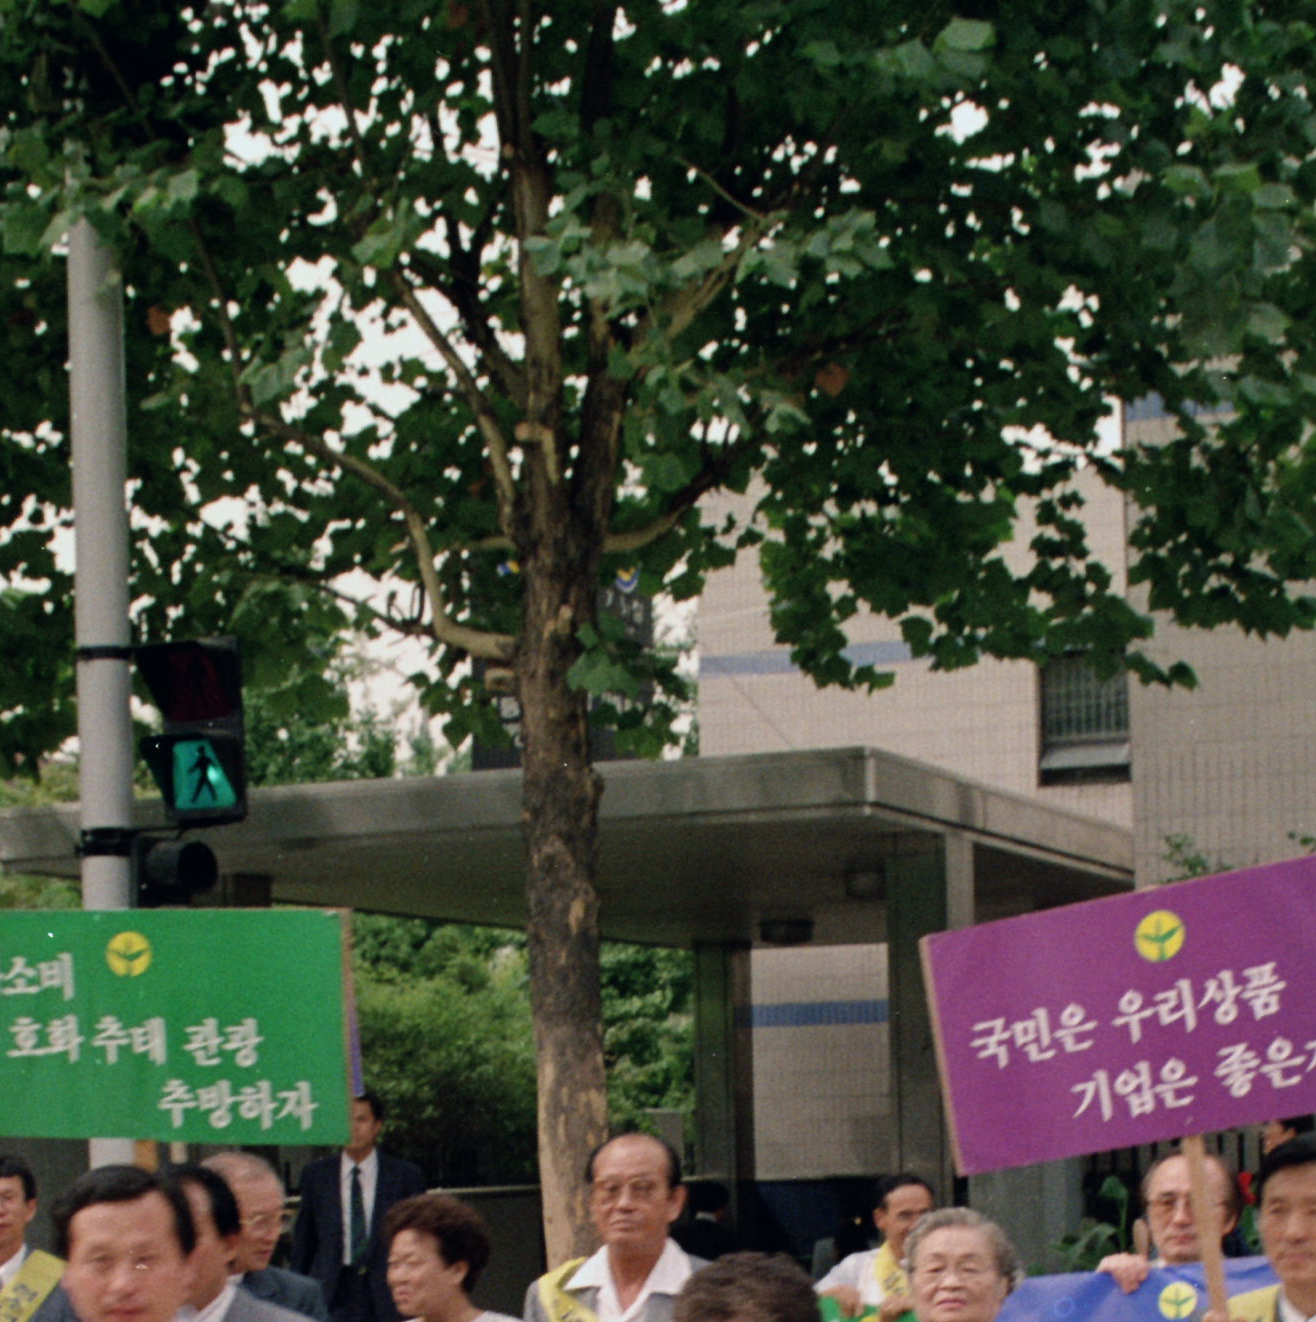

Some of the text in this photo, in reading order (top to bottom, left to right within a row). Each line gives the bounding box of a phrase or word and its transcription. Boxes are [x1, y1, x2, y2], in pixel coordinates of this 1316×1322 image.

[183, 1017, 264, 1068] 관광
[970, 961, 1286, 1069] 국민은 우리상품
[158, 1079, 318, 1130] 추방하자
[1072, 1057, 1197, 1122] 기업은
